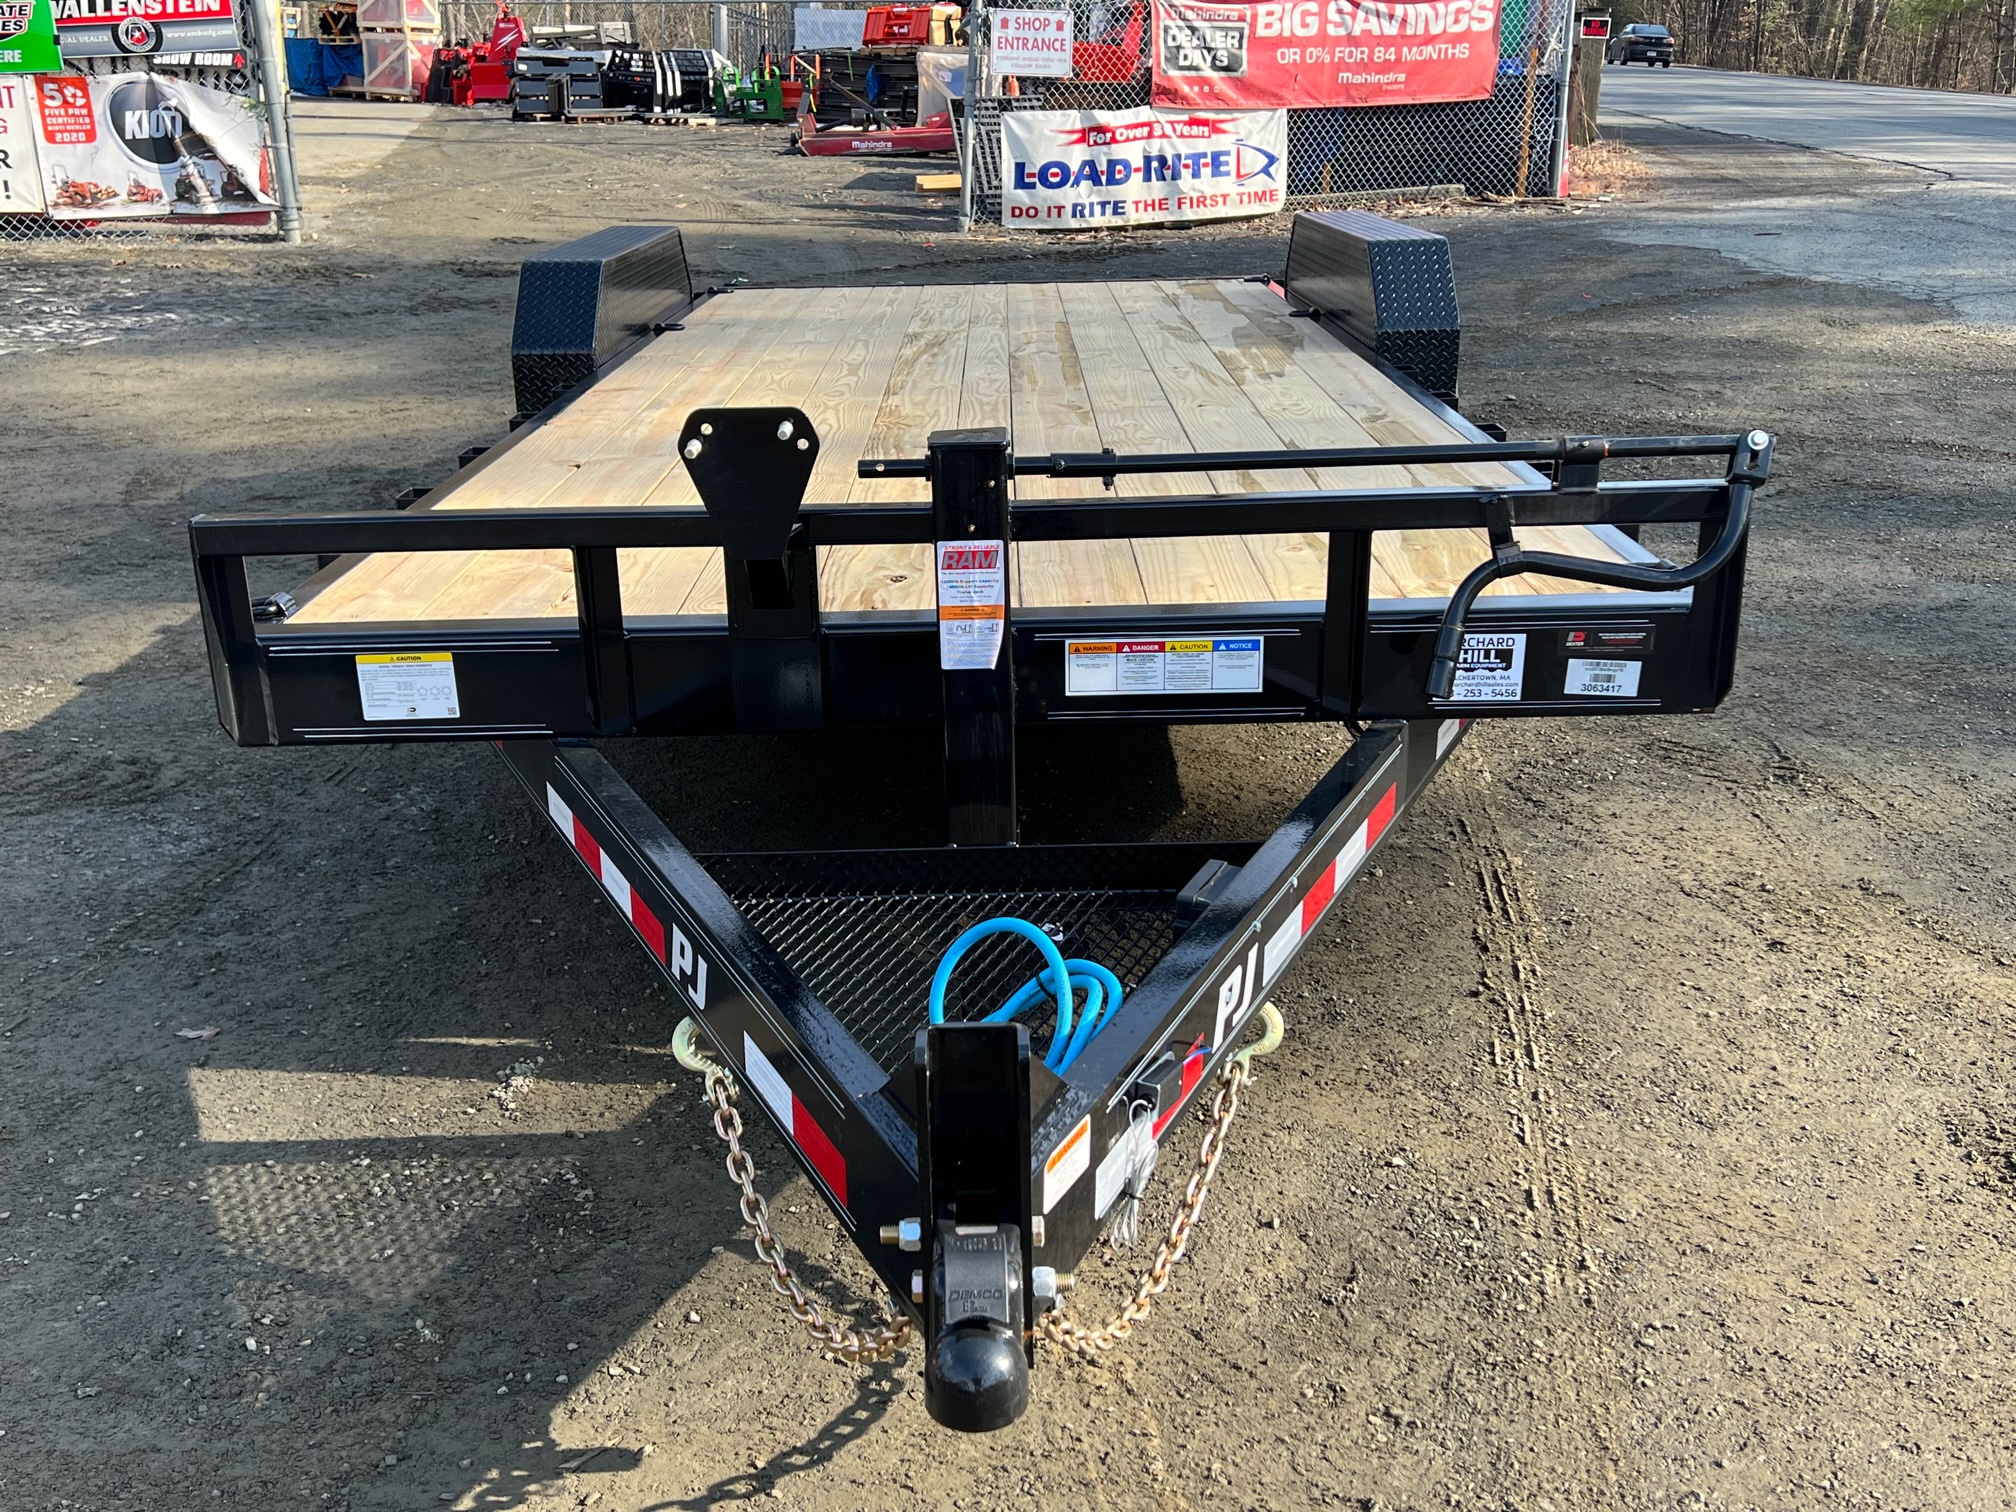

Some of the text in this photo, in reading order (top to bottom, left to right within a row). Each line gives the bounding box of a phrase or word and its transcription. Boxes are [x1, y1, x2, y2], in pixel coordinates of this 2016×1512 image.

[1172, 8, 1239, 20] Mahindra
[1255, 0, 1494, 38] BIG SAVINGS
[1014, 16, 1050, 31] SHOP
[997, 36, 1066, 52] ENTRANCE
[1167, 29, 1240, 48] DEALER
[153, 52, 232, 66] SHOW ROOM
[1179, 49, 1228, 67] DAYS
[1277, 43, 1469, 64] OR 0% FOR 84 MONTHS
[1338, 72, 1406, 84] Mahindra
[43, 83, 63, 107] 5
[45, 108, 88, 116] FIVE PAW
[55, 132, 86, 142] 2020
[1089, 131, 1111, 145] For
[1116, 126, 1149, 141] Over
[1174, 122, 1209, 137] Years
[852, 141, 892, 149] Mahindra
[1011, 189, 1279, 219] DO IT RITE THE FIRST TIME
[942, 551, 998, 569] RAM
[1459, 649, 1500, 663] HILL
[1463, 689, 1482, 697] 253
[1491, 689, 1517, 697] 5456
[1581, 684, 1622, 693] 3063417
[671, 922, 708, 1010] PJ
[1212, 942, 1259, 1053] PJ
[948, 1289, 1004, 1302] DEMCO
